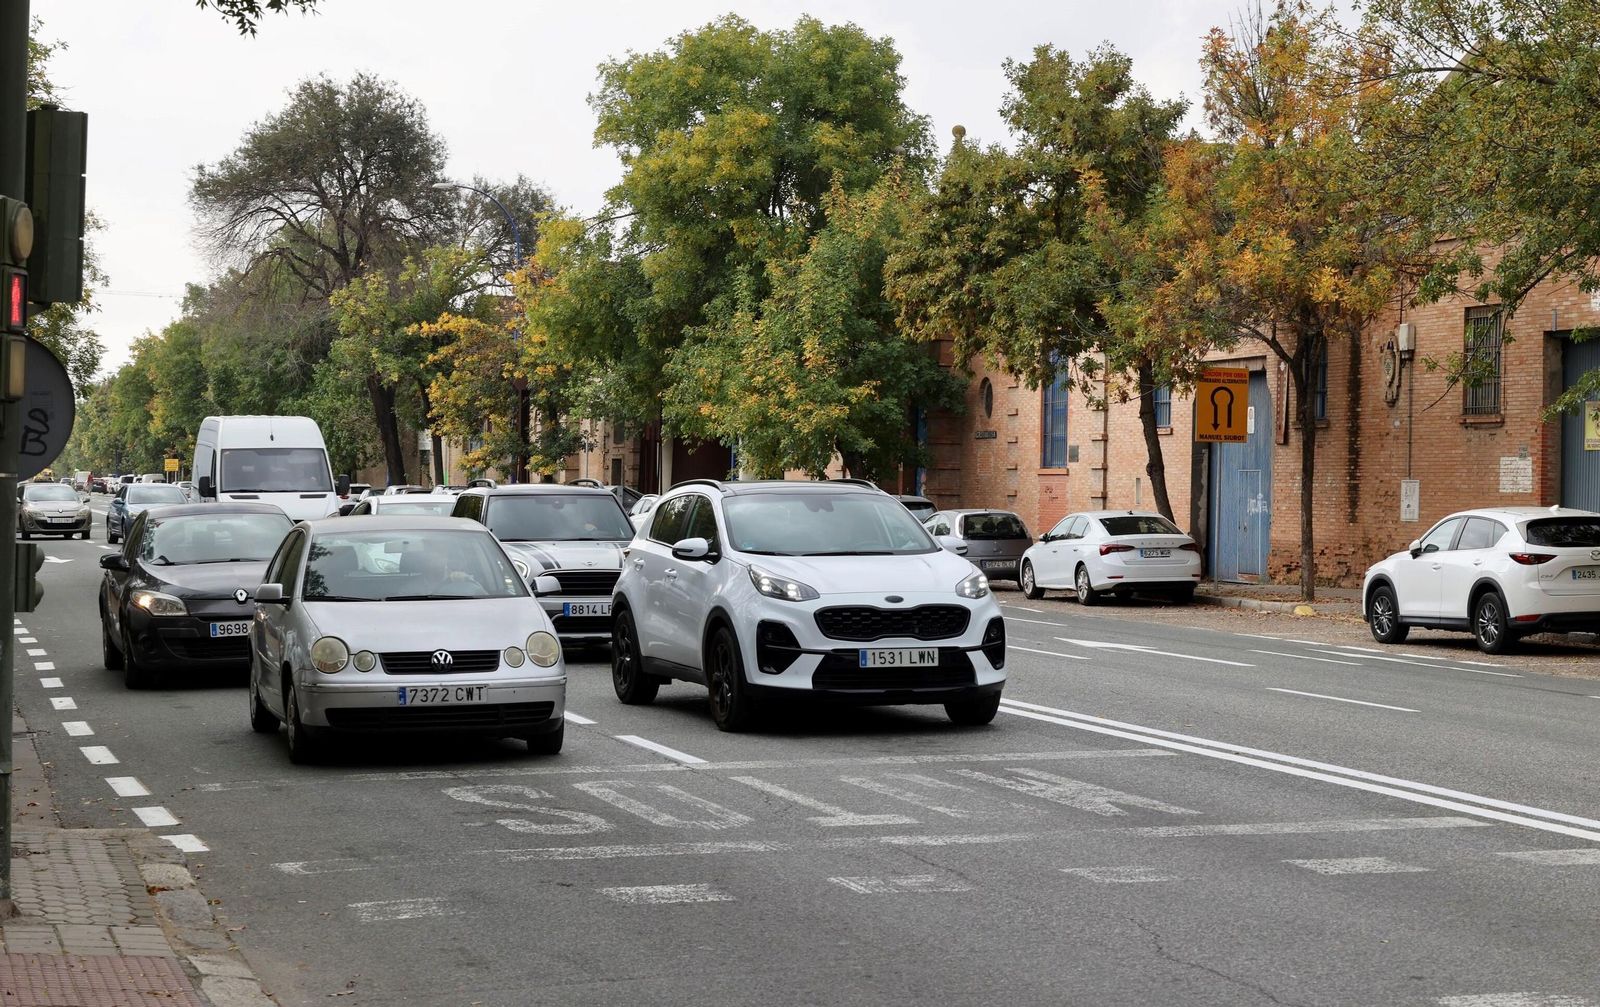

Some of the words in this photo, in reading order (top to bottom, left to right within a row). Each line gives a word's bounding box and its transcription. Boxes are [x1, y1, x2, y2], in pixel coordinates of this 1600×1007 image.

[571, 604, 597, 615] 8814
[218, 622, 248, 635] 9698
[871, 651, 903, 665] 1531
[909, 650, 935, 664] LWN
[409, 687, 450, 704] 7372
[455, 686, 484, 701] CWT
